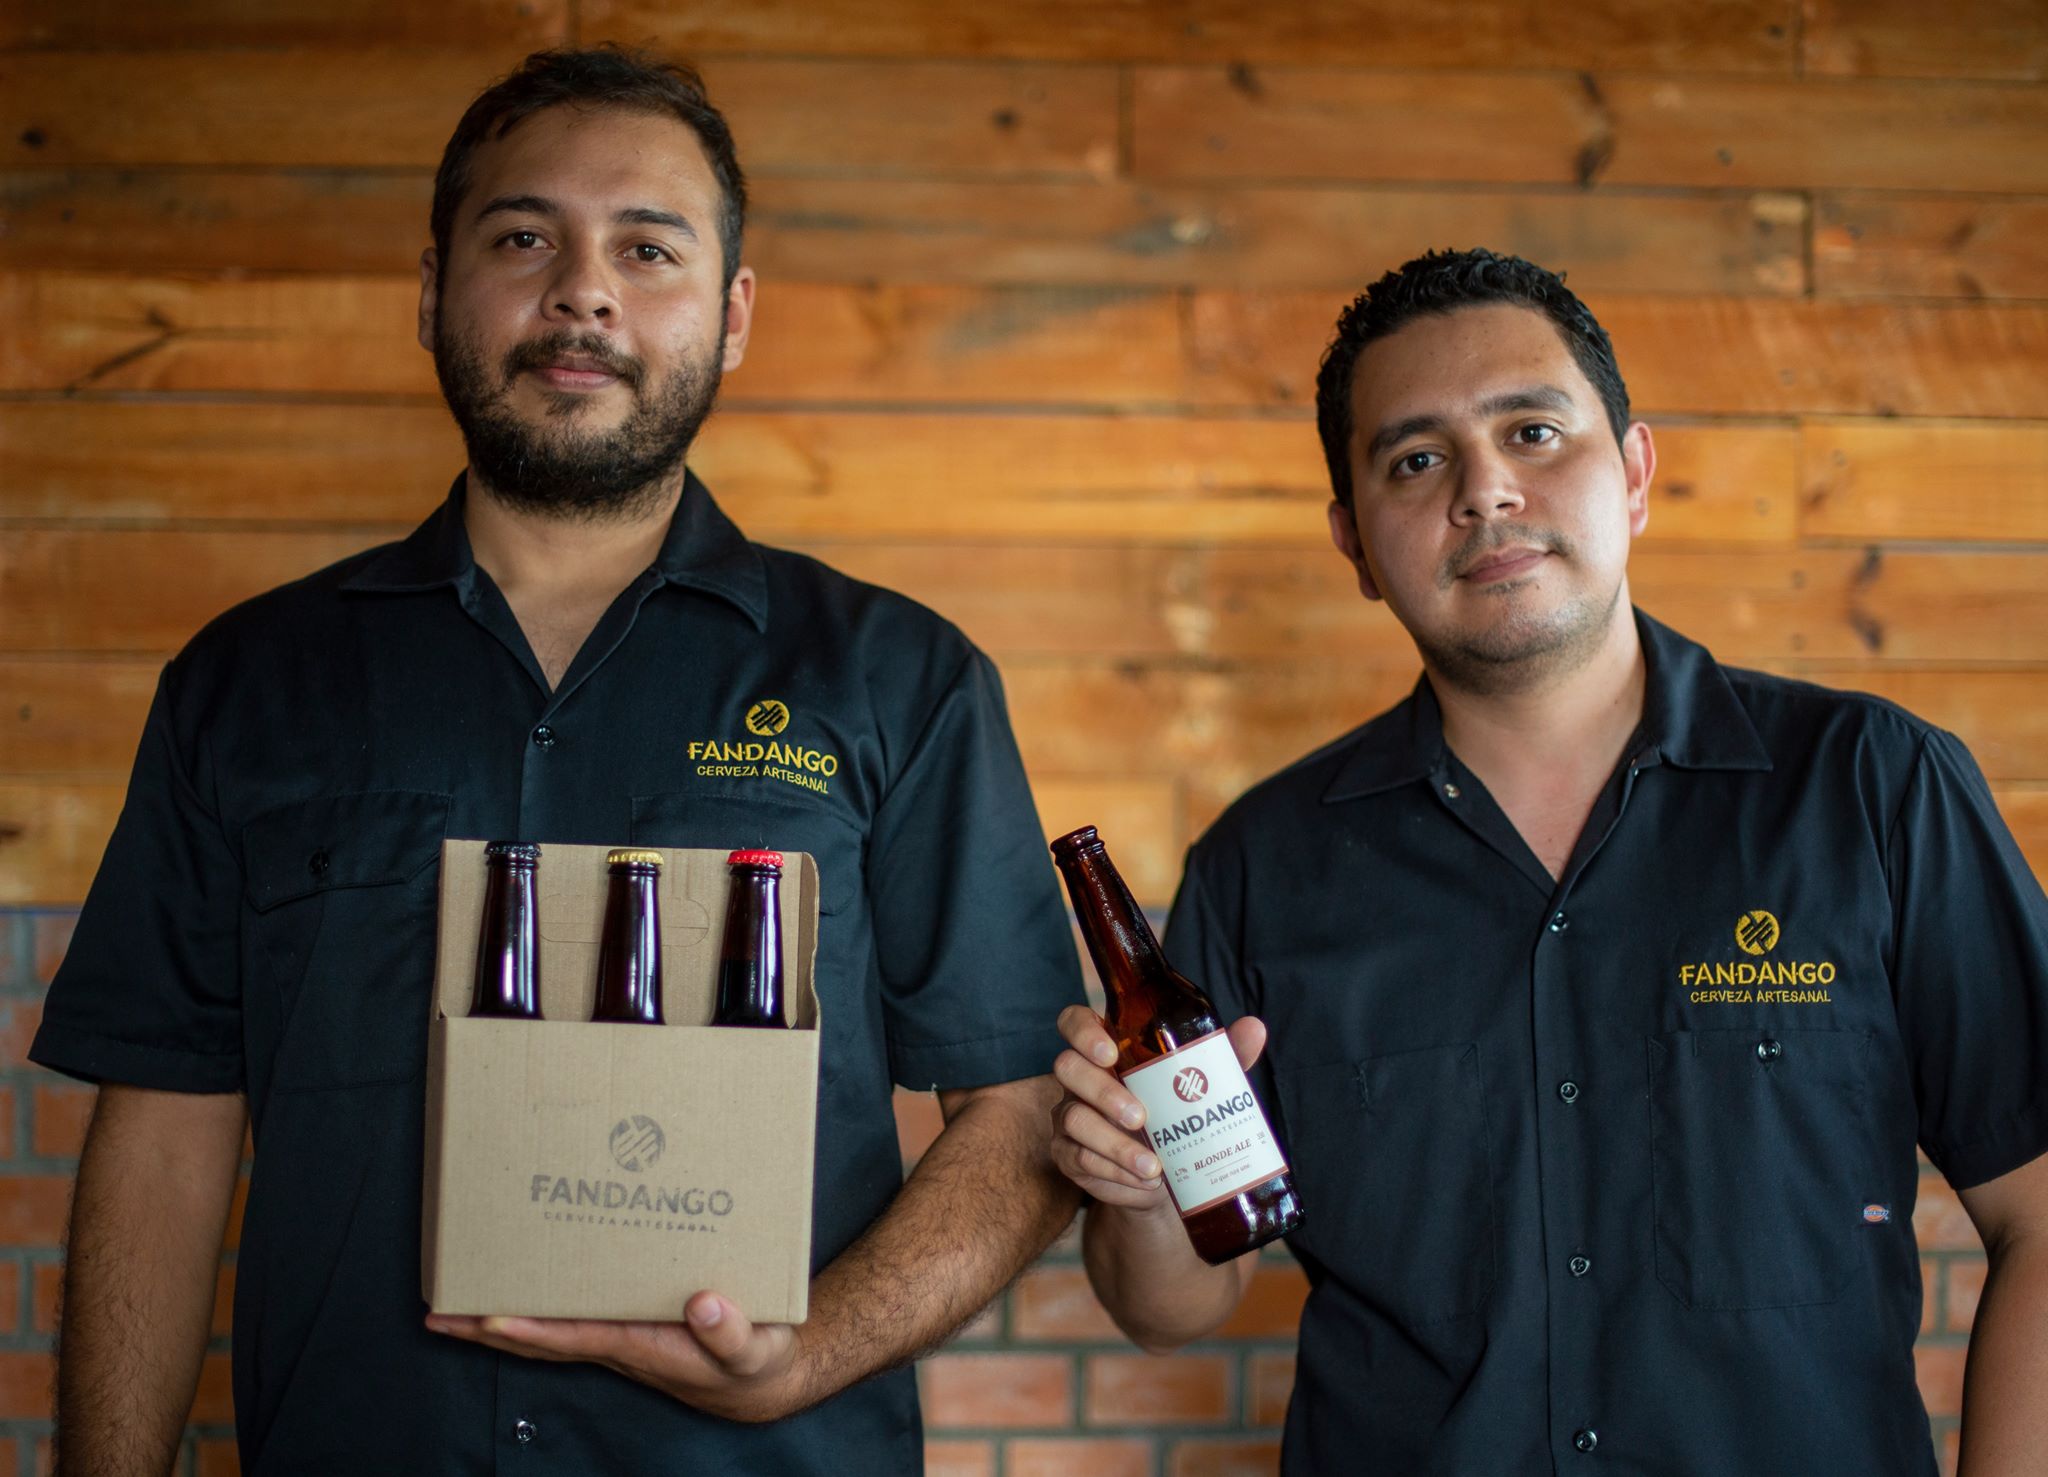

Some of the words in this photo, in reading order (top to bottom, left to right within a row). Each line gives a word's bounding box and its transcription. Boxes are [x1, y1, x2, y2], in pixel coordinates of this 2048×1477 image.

[687, 740, 838, 777] FANDANGO
[697, 765, 759, 777] CERVEZA
[763, 765, 828, 794] ARTESANAL
[1679, 961, 1836, 986] FANDANGO
[1690, 990, 1753, 1004] CERVEZA
[1756, 990, 1831, 1003] ARTESANAL
[1152, 1091, 1254, 1149] FANDANGO
[1167, 1136, 1206, 1157] CERVEZA
[1194, 1147, 1233, 1171] BLONDE
[1234, 1138, 1252, 1153] ALE
[530, 1174, 734, 1216] FANDANGO
[544, 1211, 616, 1226] CERVEZA
[622, 1218, 718, 1233] ARTESANAL
